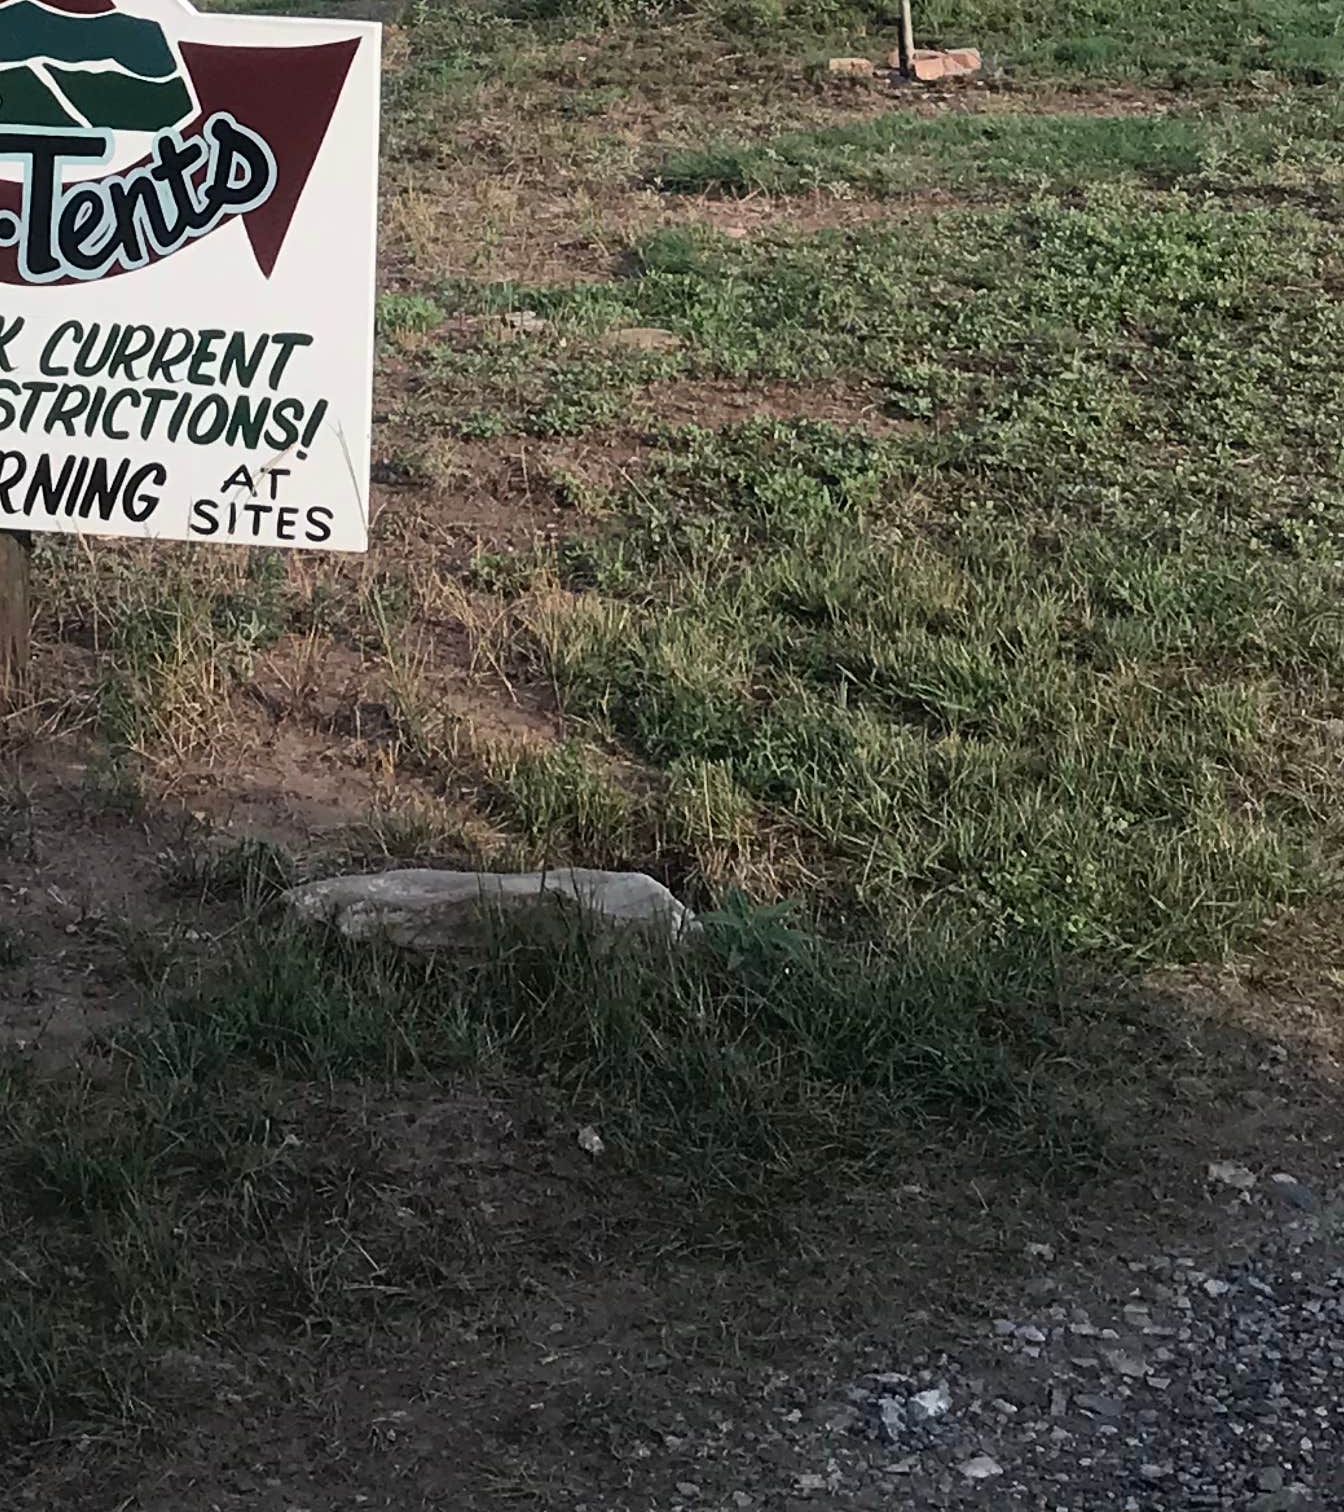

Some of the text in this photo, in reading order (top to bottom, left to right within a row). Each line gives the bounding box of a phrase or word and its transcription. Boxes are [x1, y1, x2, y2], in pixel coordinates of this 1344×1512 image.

[39, 320, 314, 391] CURRENT
[220, 464, 292, 501] AT
[189, 499, 335, 543] SITES
